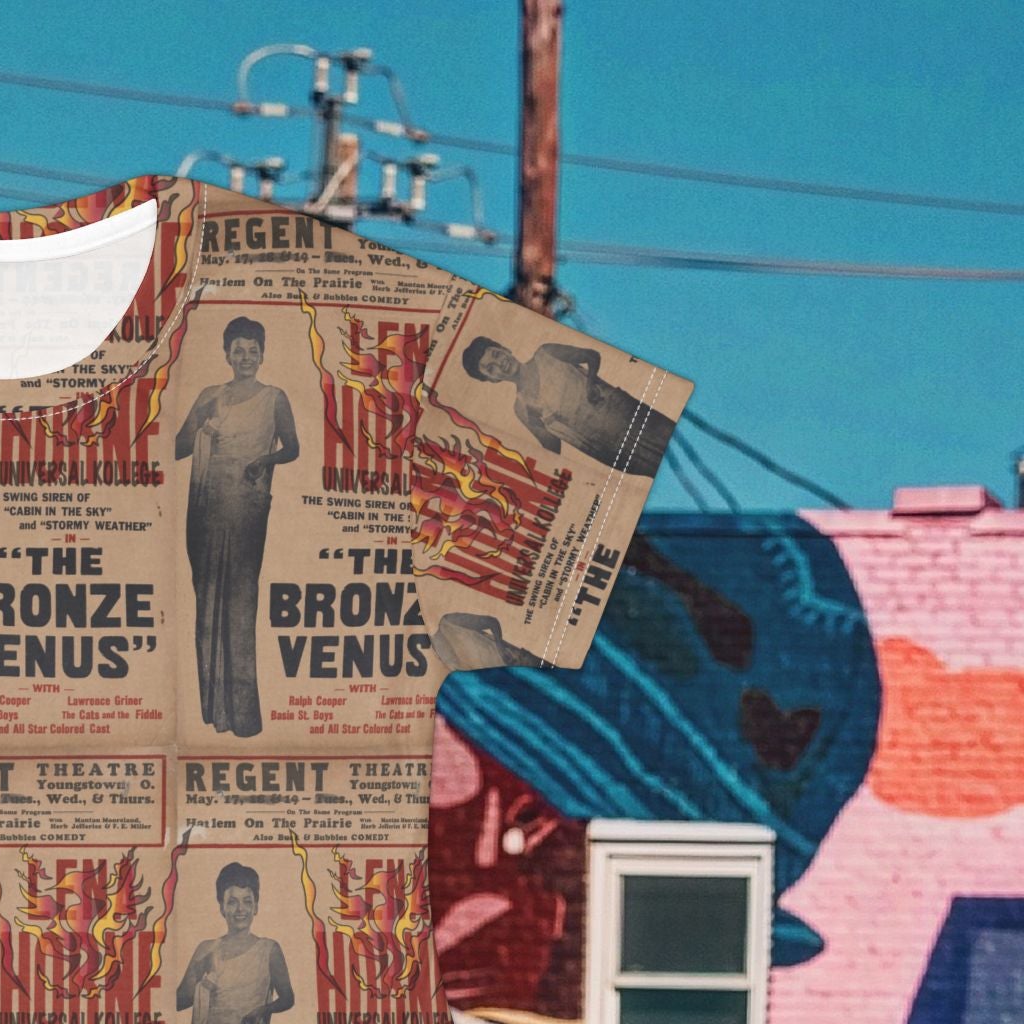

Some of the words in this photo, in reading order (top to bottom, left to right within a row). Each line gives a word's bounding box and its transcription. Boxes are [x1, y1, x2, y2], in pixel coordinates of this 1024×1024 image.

[202, 217, 334, 252] REGENT
[201, 254, 229, 267] May.
[313, 277, 363, 289] Prairie
[361, 295, 409, 305] COMEDY
[554, 549, 566, 567] THE
[504, 531, 547, 607] UNIVERSAL
[576, 561, 587, 571] IN
[550, 568, 559, 579] IN
[524, 608, 535, 625] THE
[530, 580, 542, 608] SWING
[540, 553, 555, 579] SIREN
[550, 537, 559, 550] OF
[36, 763, 155, 776] THEATRE
[185, 762, 330, 792] REGENT
[140, 779, 155, 790] O.
[46, 793, 87, 805] Wed.,
[91, 793, 104, 804] &
[110, 793, 155, 804] Thurs.
